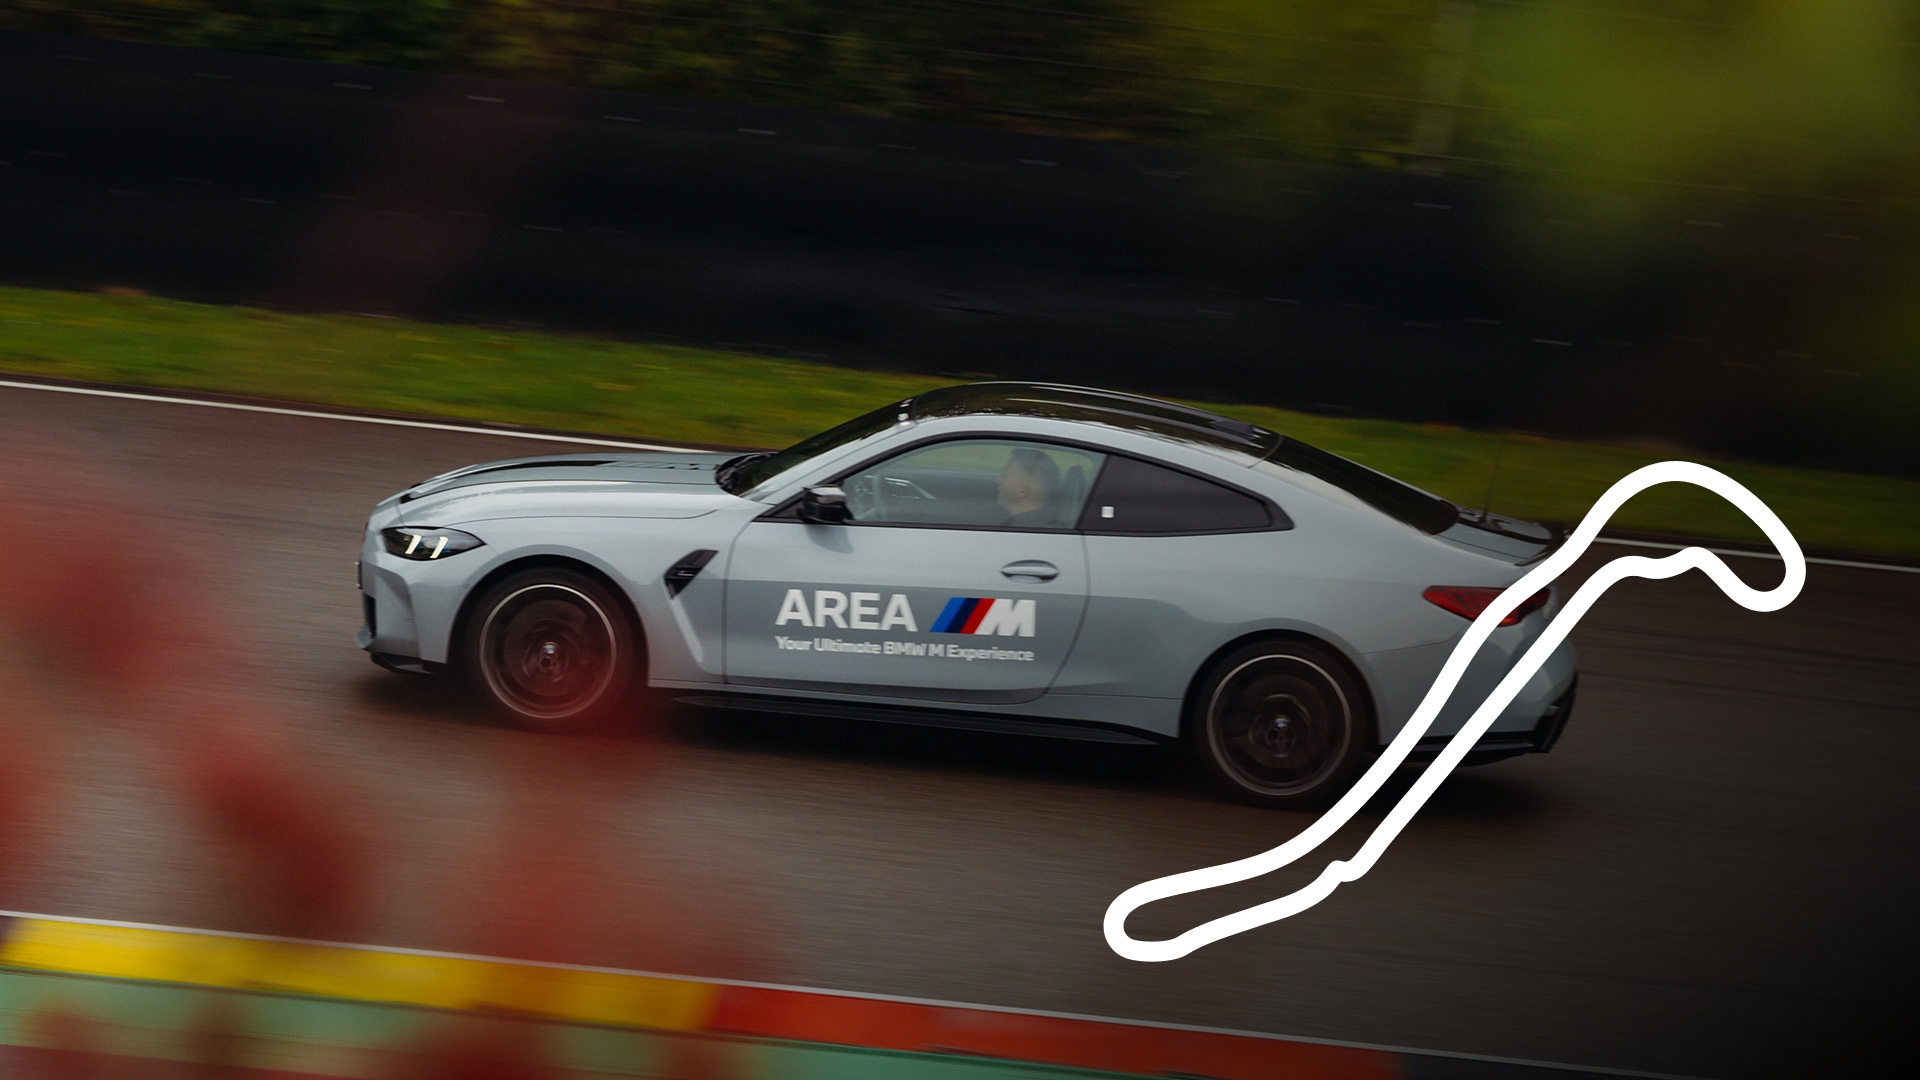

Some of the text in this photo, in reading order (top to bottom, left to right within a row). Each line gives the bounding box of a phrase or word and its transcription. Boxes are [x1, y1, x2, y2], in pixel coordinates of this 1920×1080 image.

[775, 588, 1036, 637] AREA M
[775, 636, 1034, 662] Your Ultimate BMW M Experience
